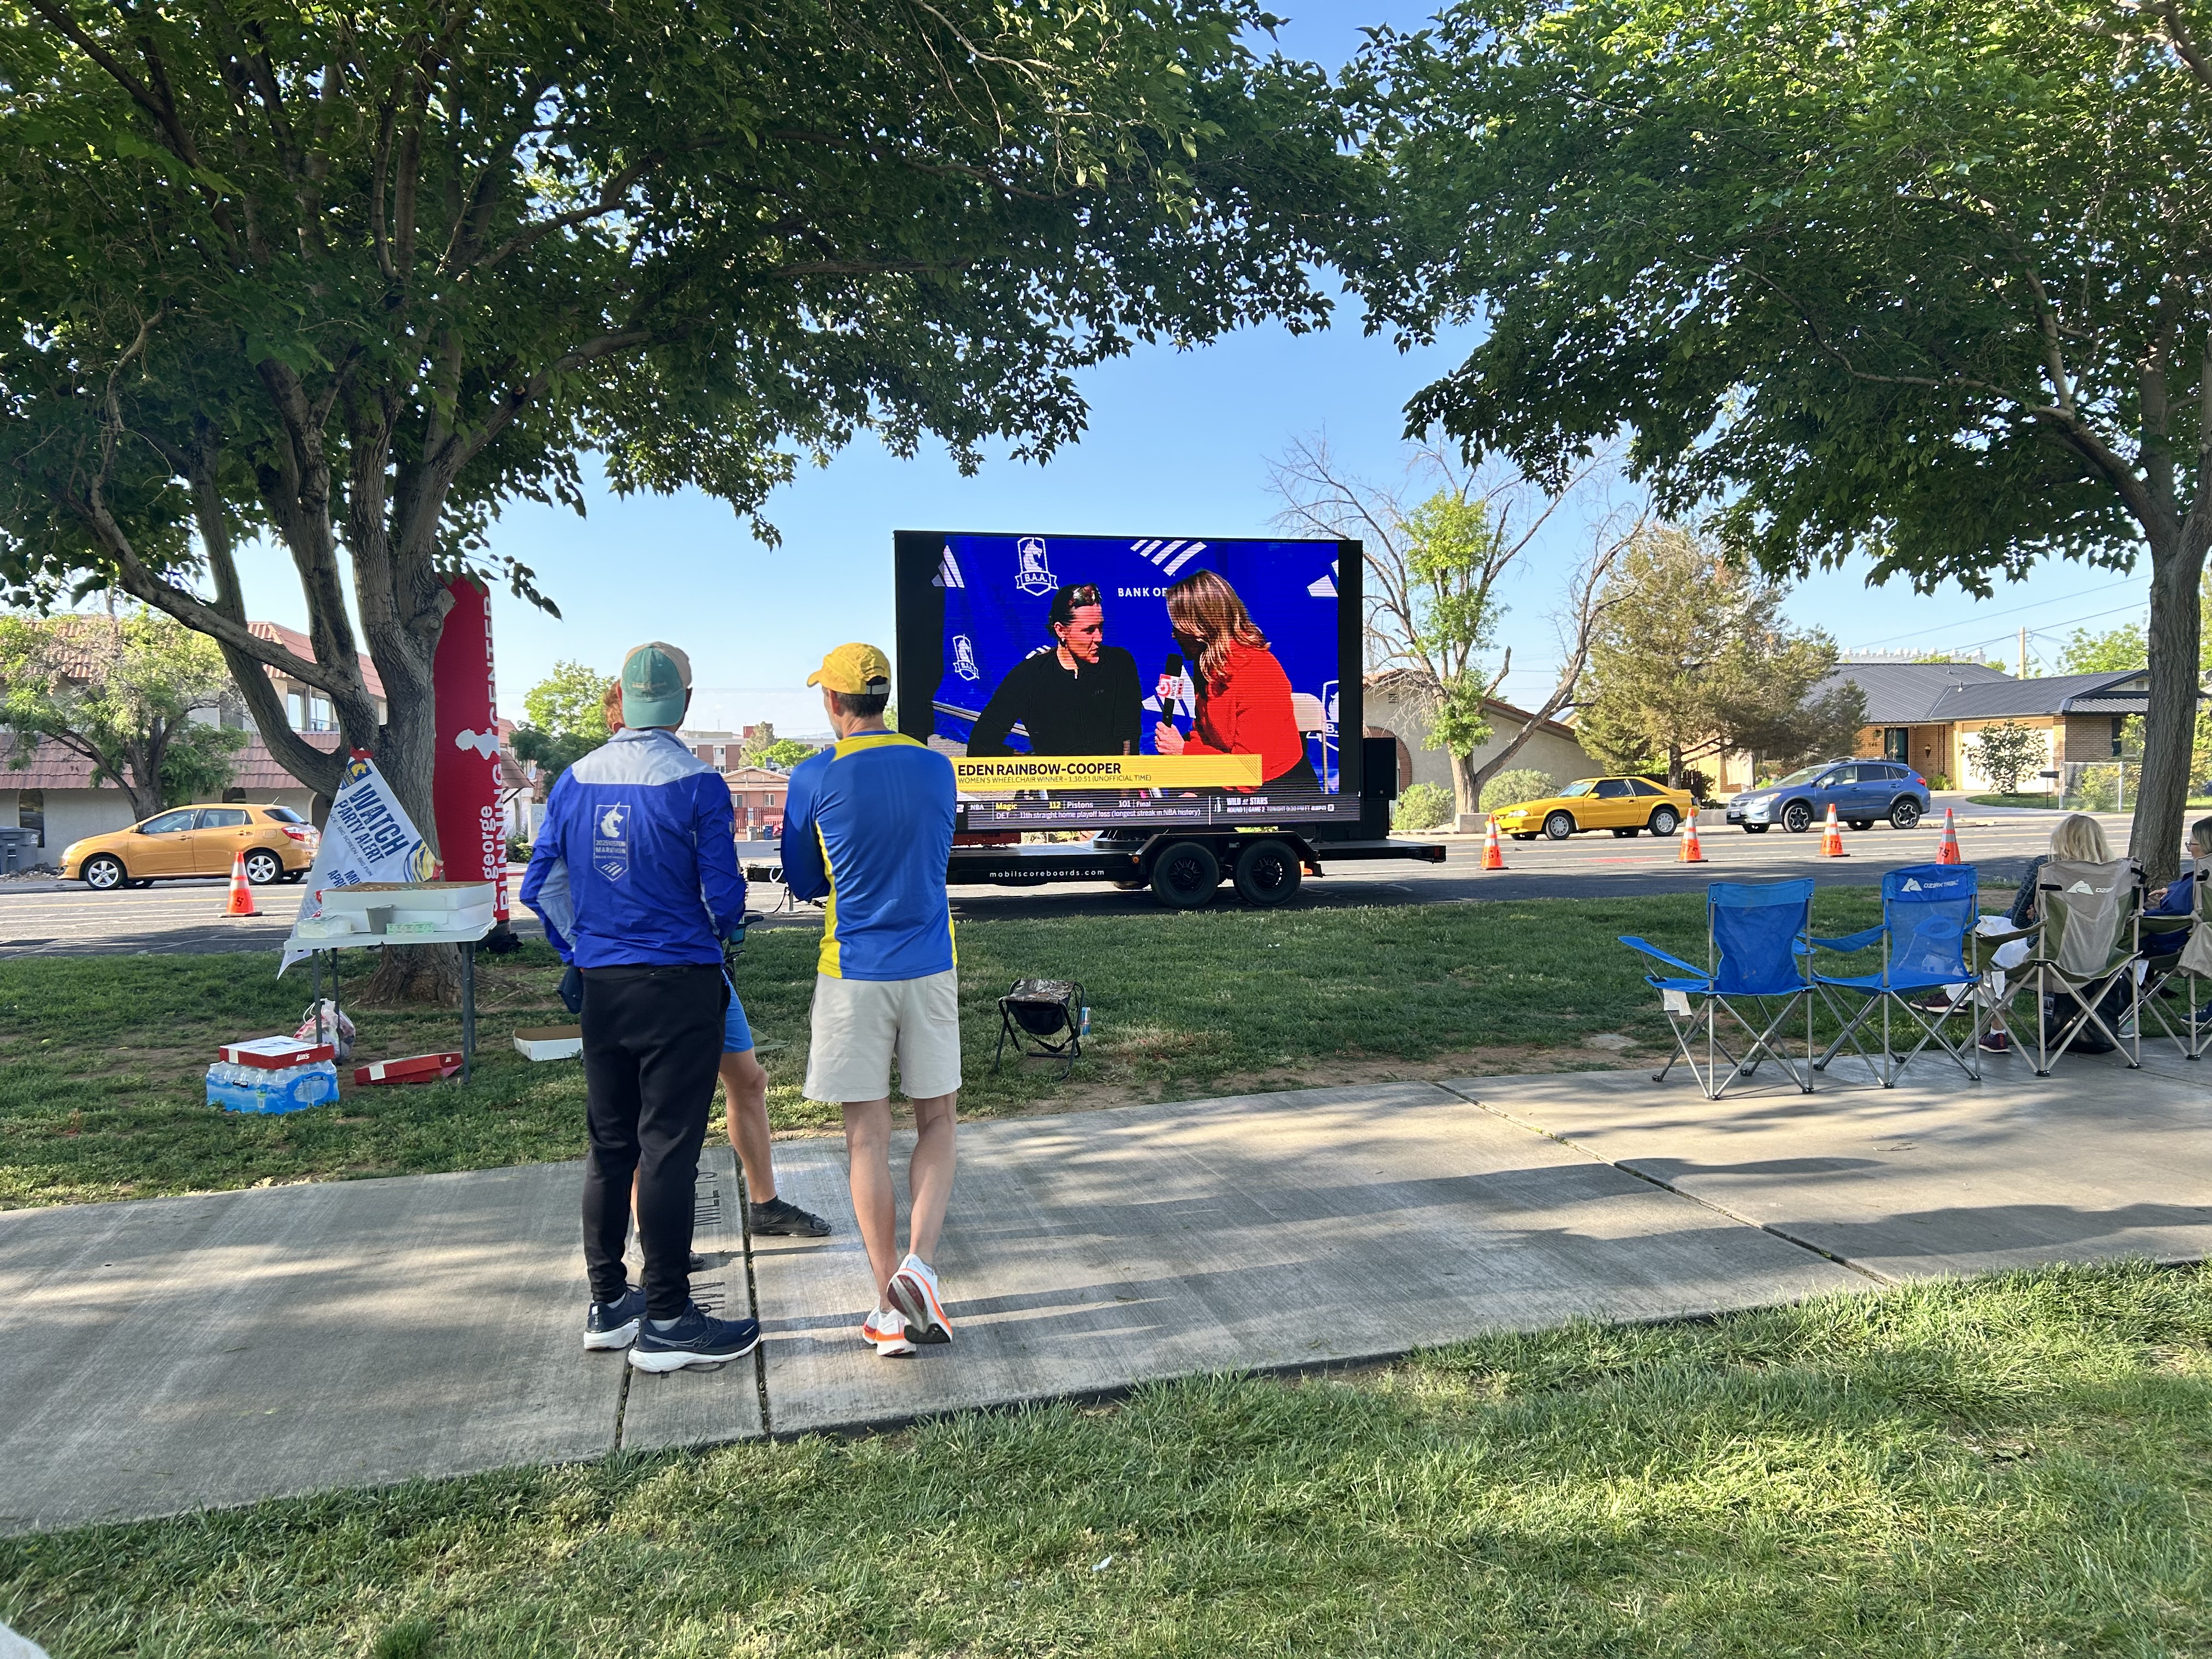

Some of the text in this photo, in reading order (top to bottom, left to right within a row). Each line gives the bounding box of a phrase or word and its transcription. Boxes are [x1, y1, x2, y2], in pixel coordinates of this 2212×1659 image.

[1118, 587, 1149, 597] BANK
[958, 762, 1121, 776] EDEN RAINBOW-COOPER
[995, 800, 1062, 811] Magic 112
[1066, 800, 1093, 809] Pistons
[1118, 800, 1131, 808] 101
[348, 783, 410, 856] WATCH
[1034, 811, 1057, 820] straight
[1076, 810, 1098, 819] playoff
[1111, 809, 1136, 818] (longest
[1177, 808, 1201, 816] history)
[334, 799, 385, 864] PARTY ALERT
[481, 805, 499, 879] george
[337, 826, 345, 836] BIG
[343, 834, 358, 854] SCREEN
[357, 857, 365, 867] BIG
[363, 864, 374, 877] FUN
[344, 870, 361, 884] MO
[989, 869, 1105, 878] mobilscoreboards.com
